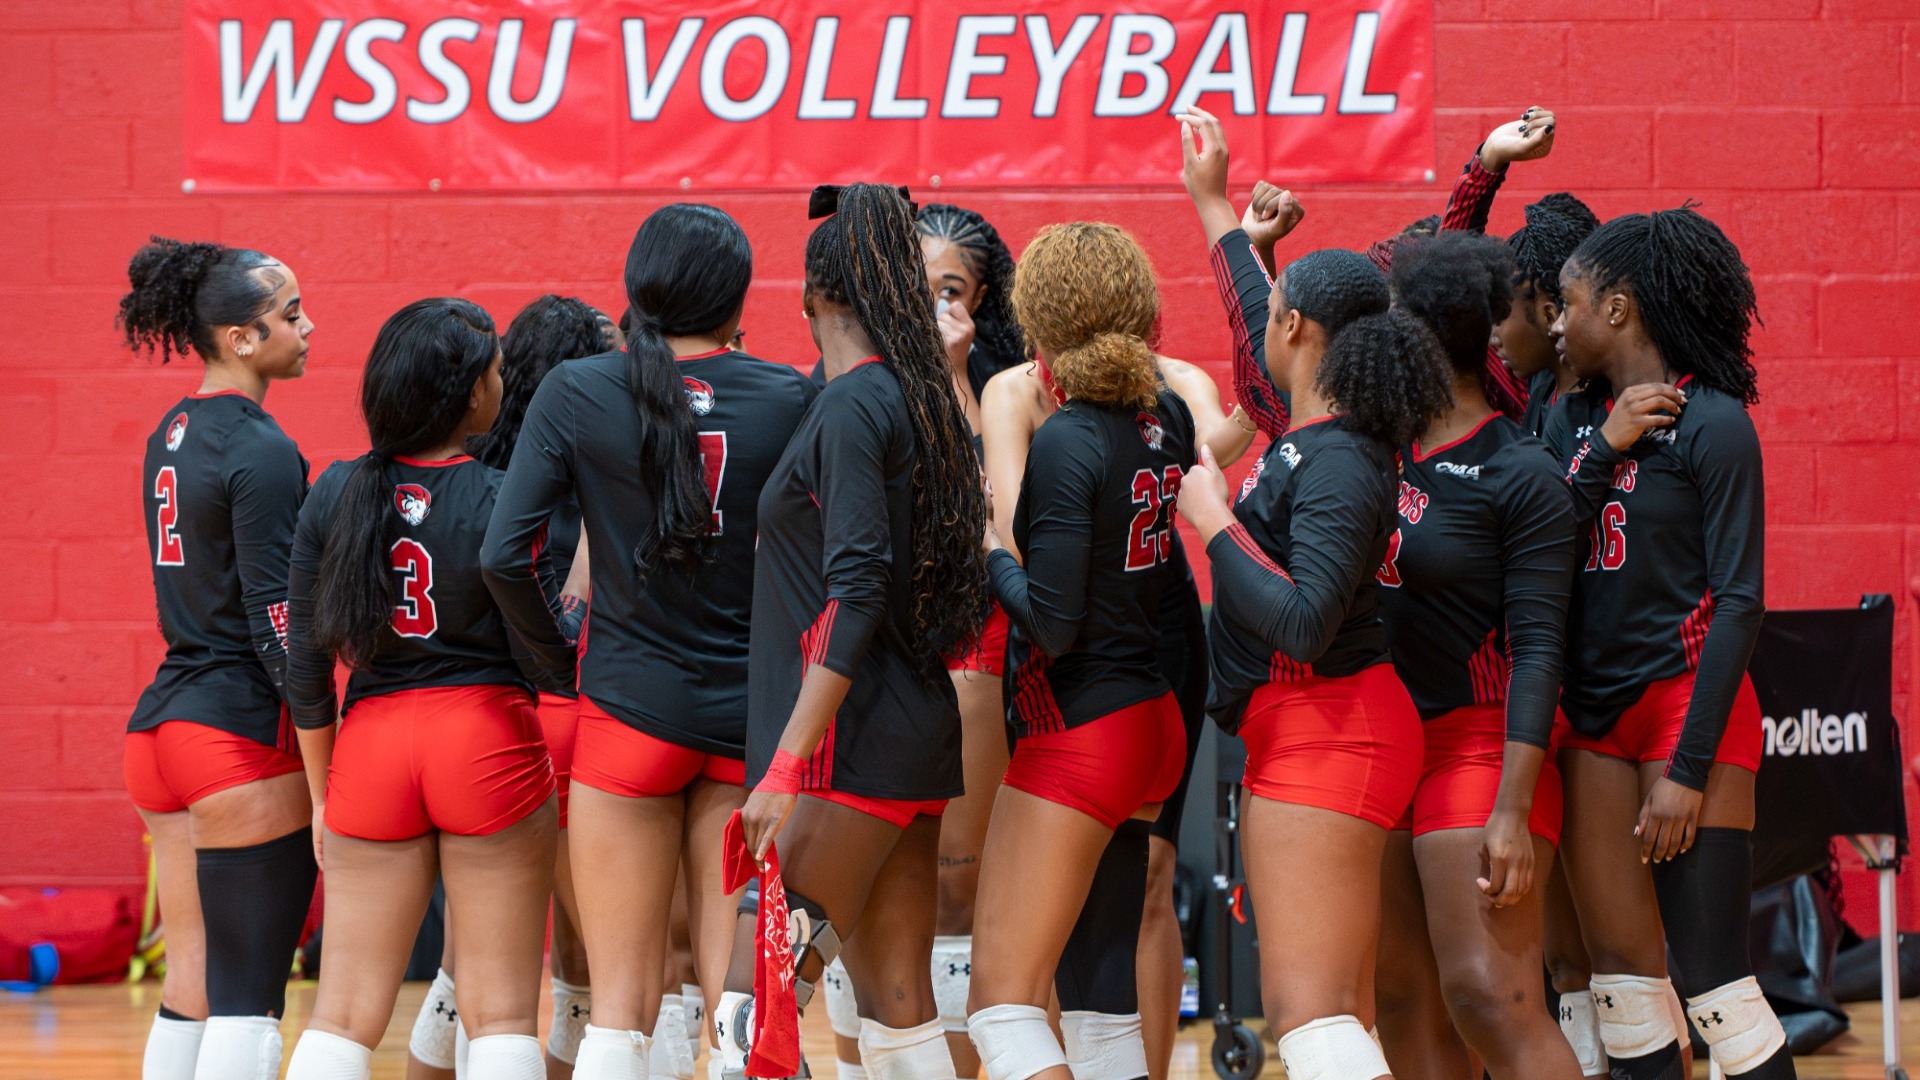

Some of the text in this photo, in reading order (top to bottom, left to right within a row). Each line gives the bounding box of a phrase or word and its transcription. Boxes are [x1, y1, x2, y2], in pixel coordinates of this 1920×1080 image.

[218, 11, 1398, 125] WSSU VOLLEYBALL
[154, 466, 185, 566] 2
[390, 537, 438, 639] 3
